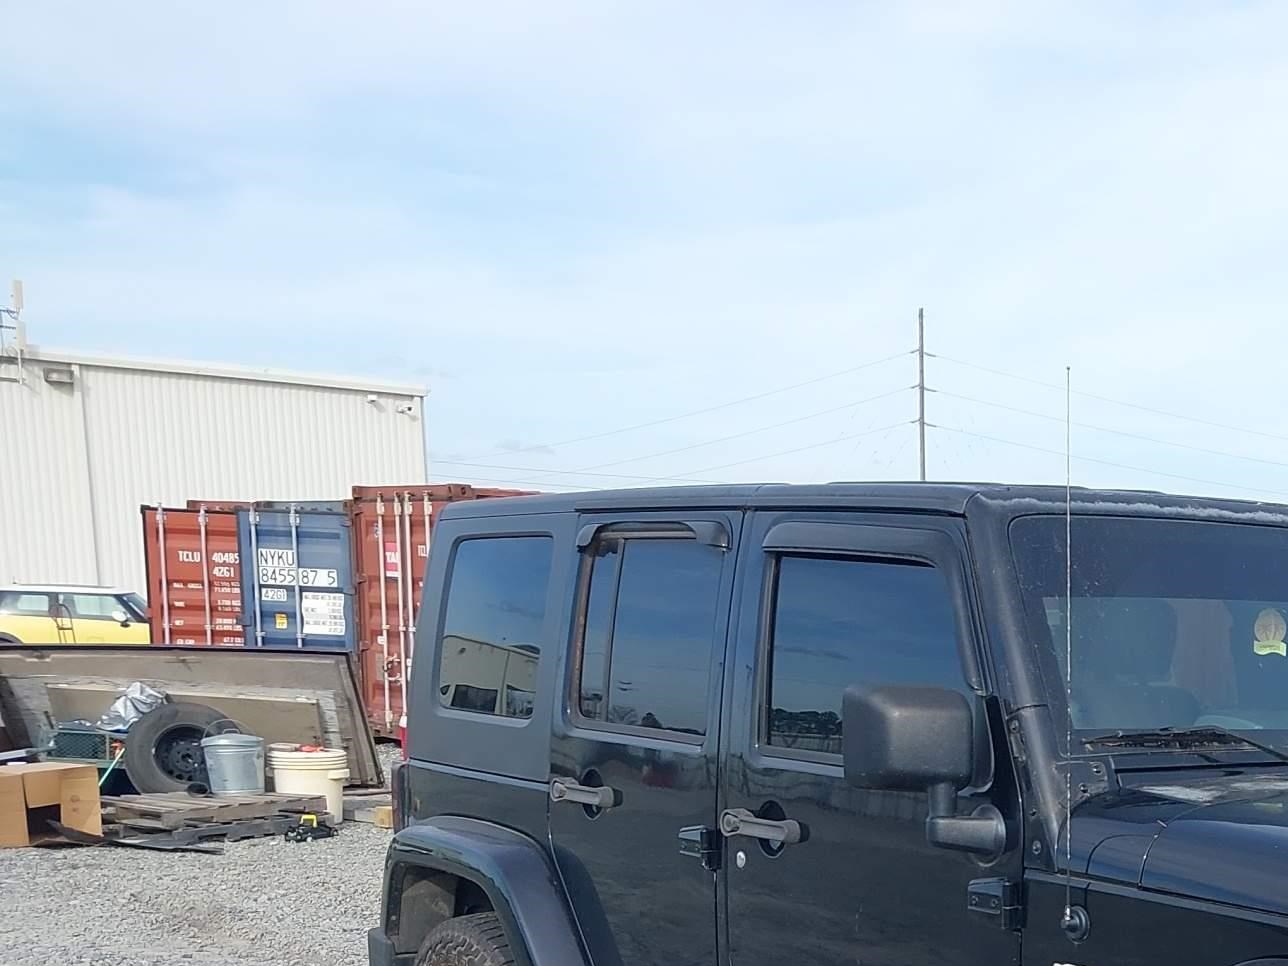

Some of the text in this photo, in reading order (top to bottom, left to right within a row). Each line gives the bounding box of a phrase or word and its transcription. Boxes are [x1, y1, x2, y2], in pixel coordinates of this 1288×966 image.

[177, 550, 201, 563] TCLU
[259, 549, 295, 567] NYKU
[327, 570, 336, 586] 5
[263, 589, 286, 600] 42G1
